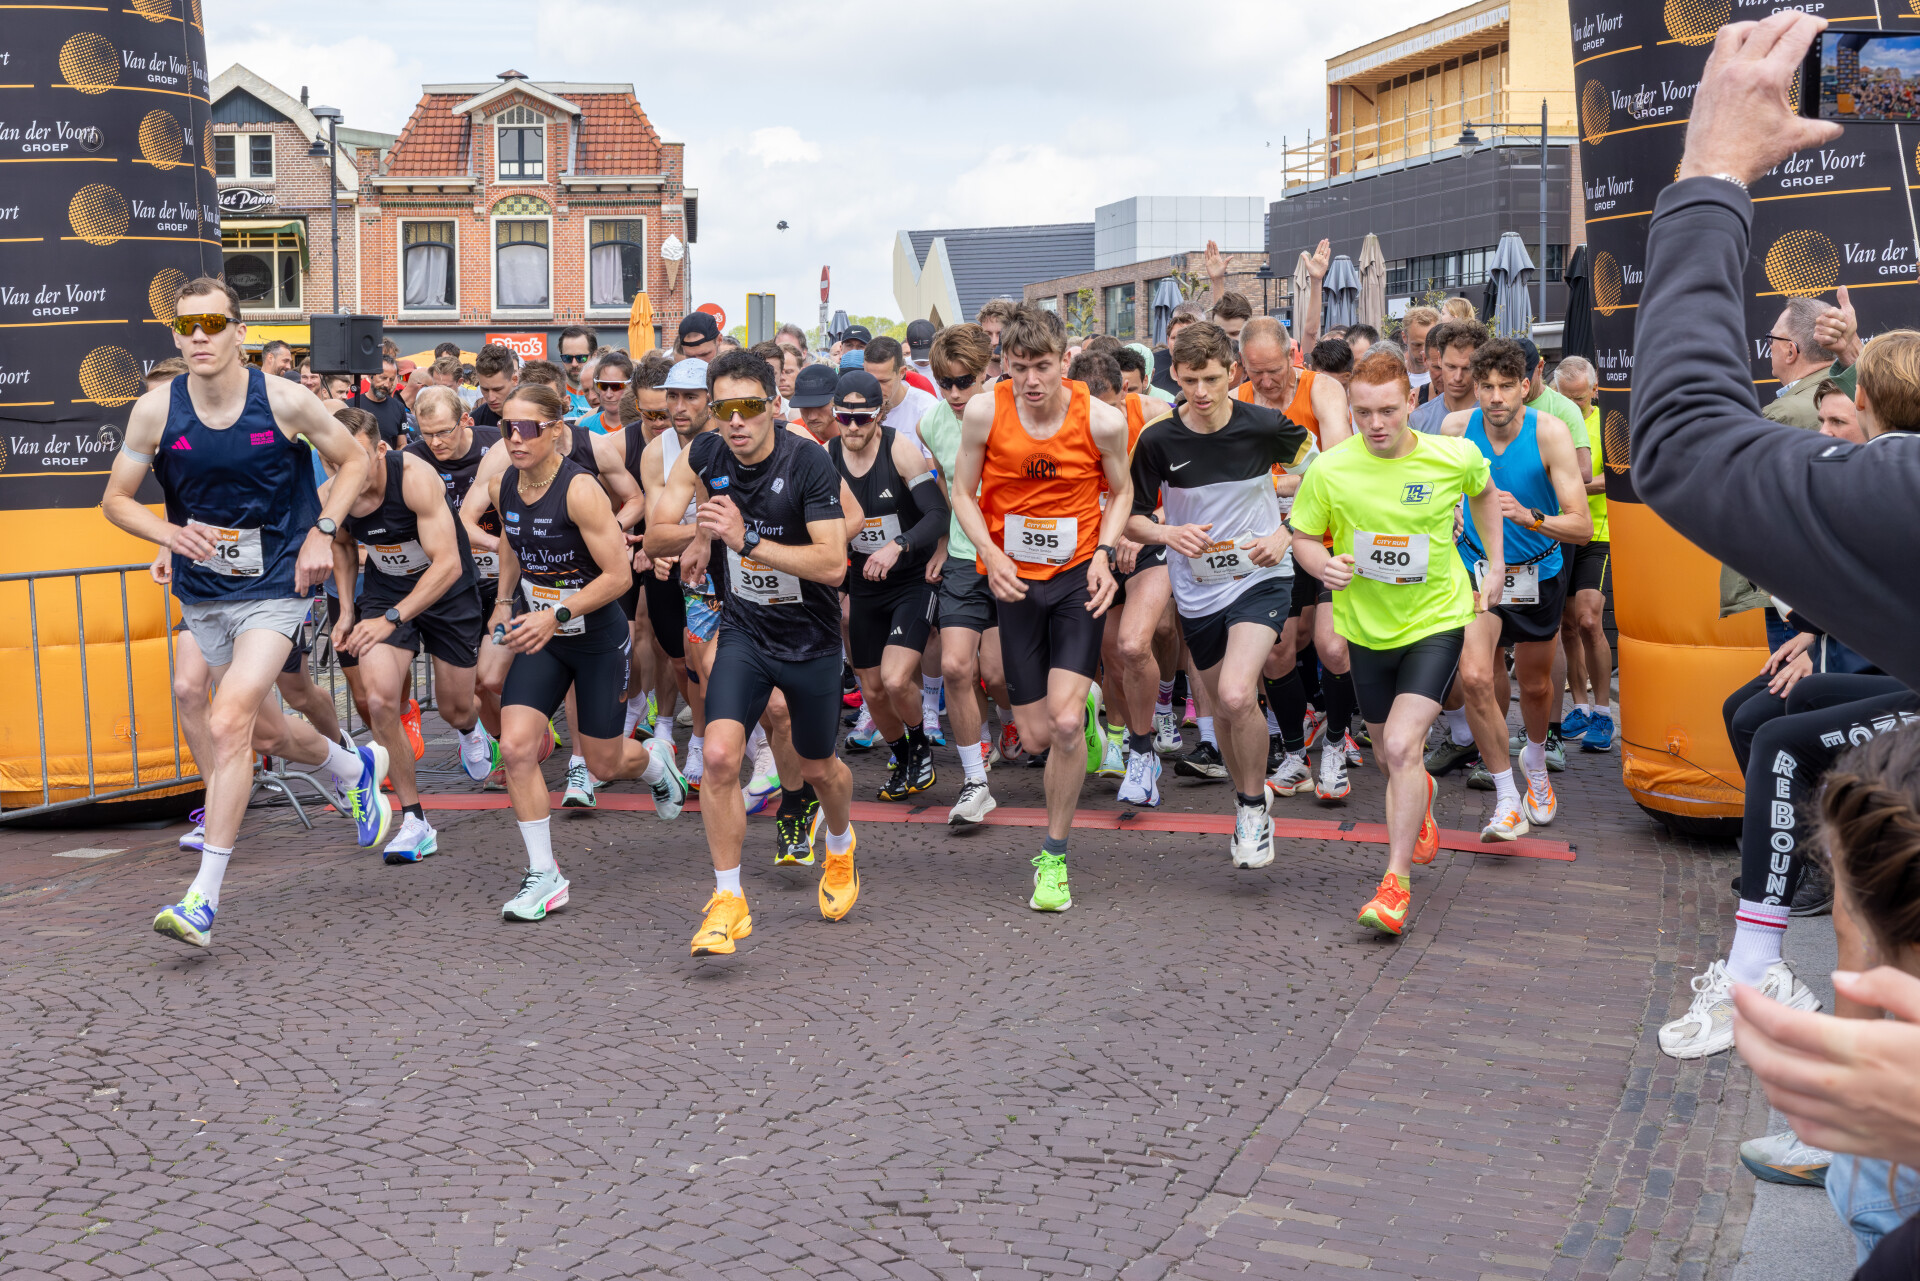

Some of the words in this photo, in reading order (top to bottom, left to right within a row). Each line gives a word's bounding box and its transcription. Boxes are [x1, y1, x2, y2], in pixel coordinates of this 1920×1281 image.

[1583, 18, 1594, 38] der
[1596, 13, 1623, 34] Voort
[1583, 38, 1605, 51] GROEP
[122, 50, 146, 69] Van
[149, 52, 166, 72] der
[169, 56, 188, 75] Voor
[148, 74, 178, 84] GROEP
[1612, 90, 1631, 111] Van
[1635, 84, 1657, 104] der
[1633, 105, 1673, 120] GROEP
[26, 120, 51, 140] der
[56, 121, 96, 140] Voort
[22, 144, 68, 152] GROEP
[1784, 152, 1814, 174] der
[1819, 149, 1866, 171] Voort
[1595, 178, 1606, 198] der
[1608, 176, 1634, 196] Voort
[1781, 175, 1834, 188] GROEP
[218, 193, 236, 205] iet
[1594, 200, 1616, 211] GROEP
[132, 200, 155, 218] Van
[159, 200, 177, 220] der
[180, 202, 197, 220] Voor
[158, 223, 188, 231] GROEP
[1844, 243, 1876, 264] Van
[1881, 239, 1908, 261] der
[1623, 265, 1643, 285] Van
[1878, 264, 1917, 275] GROE
[0, 286, 30, 305] Van
[35, 284, 60, 304] der
[66, 284, 106, 303] Voort
[32, 307, 79, 316] GROEP
[1607, 349, 1617, 368] der
[1619, 349, 1634, 368] Voo
[0, 366, 30, 384] oort
[1607, 372, 1627, 381] GROEP
[10, 436, 39, 455] Van
[45, 434, 70, 454] der
[76, 435, 116, 453] Voort
[1027, 459, 1056, 479] HERA
[754, 520, 783, 535] Voort
[860, 530, 885, 541] 331
[1022, 532, 1058, 548] 395
[214, 545, 239, 558] 16
[521, 547, 536, 562] der
[538, 550, 574, 563] Voort
[1370, 550, 1410, 566] 480
[381, 555, 409, 564] 412
[475, 556, 493, 566] 29
[1206, 554, 1239, 568] 128
[527, 563, 548, 572] Groep
[741, 571, 779, 588] 308
[533, 601, 550, 612] 30
